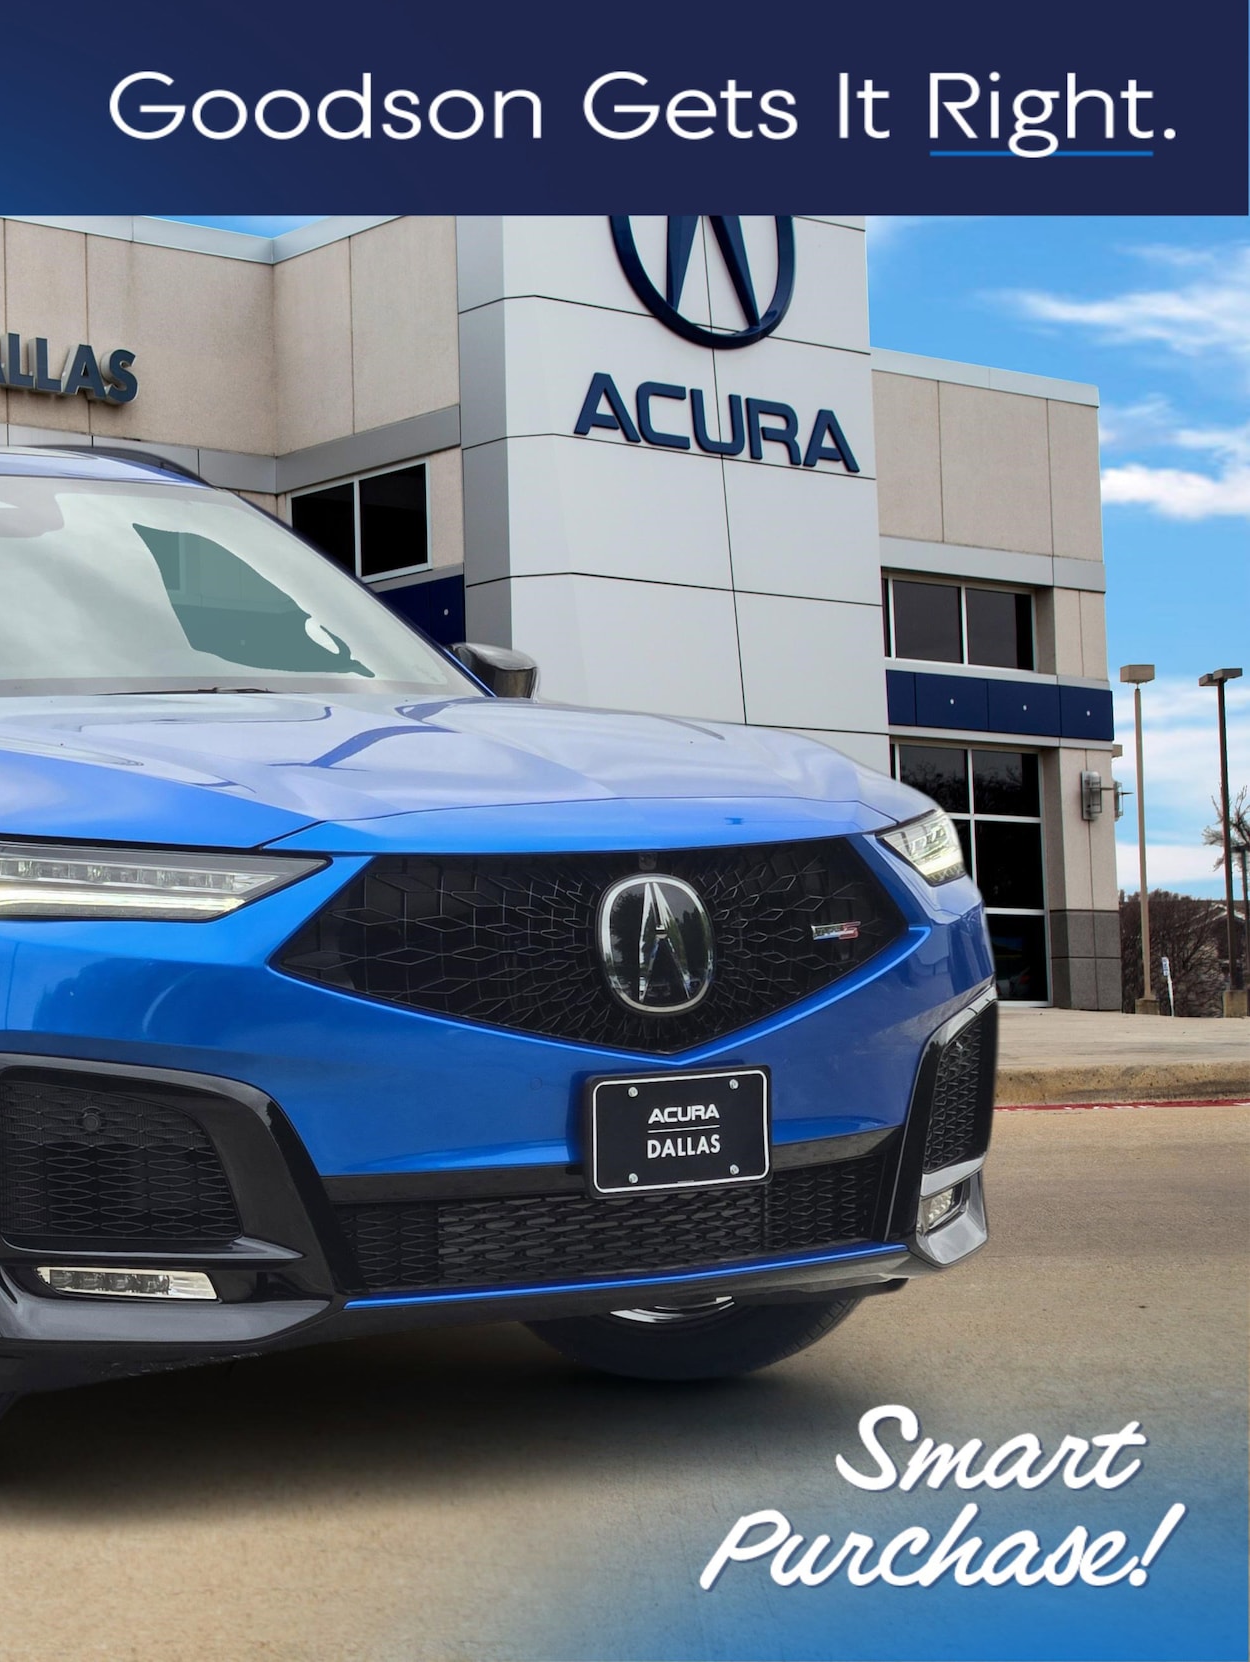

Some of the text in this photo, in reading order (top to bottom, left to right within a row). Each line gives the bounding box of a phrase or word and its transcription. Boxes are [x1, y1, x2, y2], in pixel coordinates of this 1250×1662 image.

[574, 372, 860, 473] ACURA
[648, 1103, 720, 1125] ACURA
[647, 1134, 721, 1160] DALLAS
